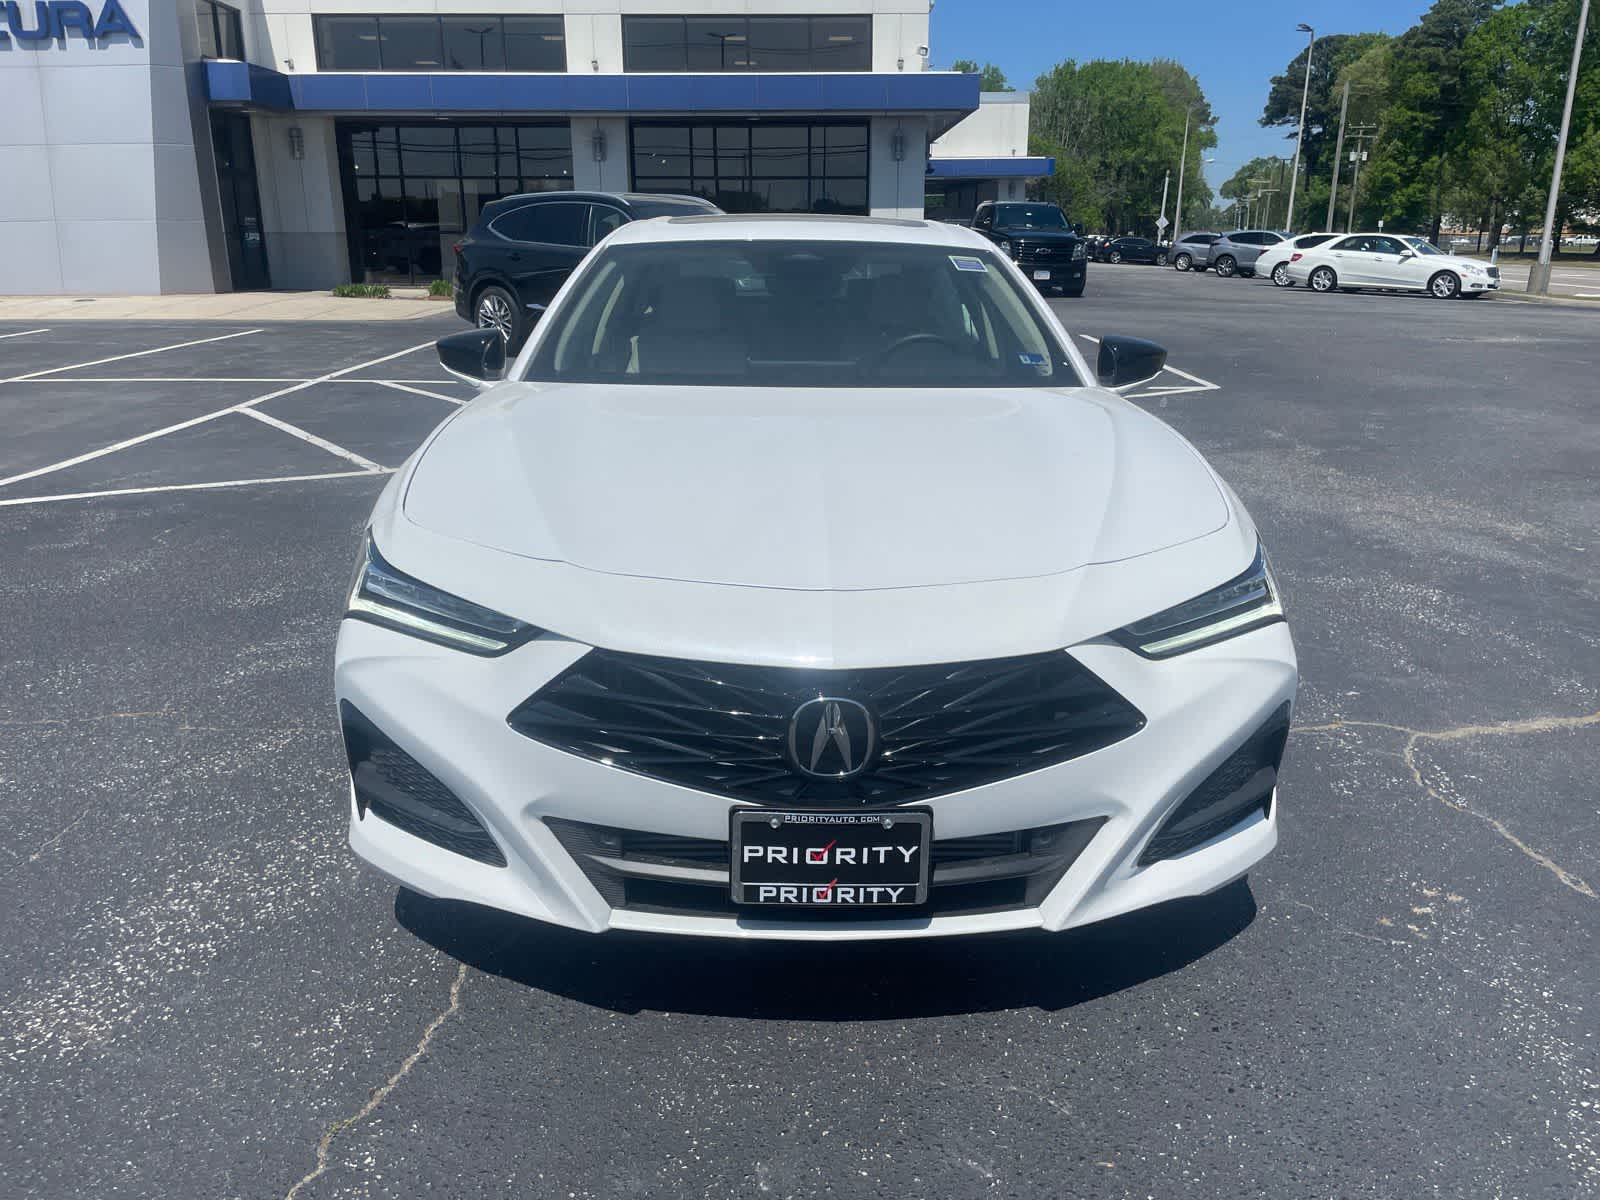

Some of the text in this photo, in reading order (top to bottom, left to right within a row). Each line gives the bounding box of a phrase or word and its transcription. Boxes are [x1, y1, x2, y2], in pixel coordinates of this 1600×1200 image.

[784, 815, 880, 823] PRIORITYAUTO.COM
[743, 845, 919, 864] PRIORITY
[759, 886, 904, 903] PRIORITY
